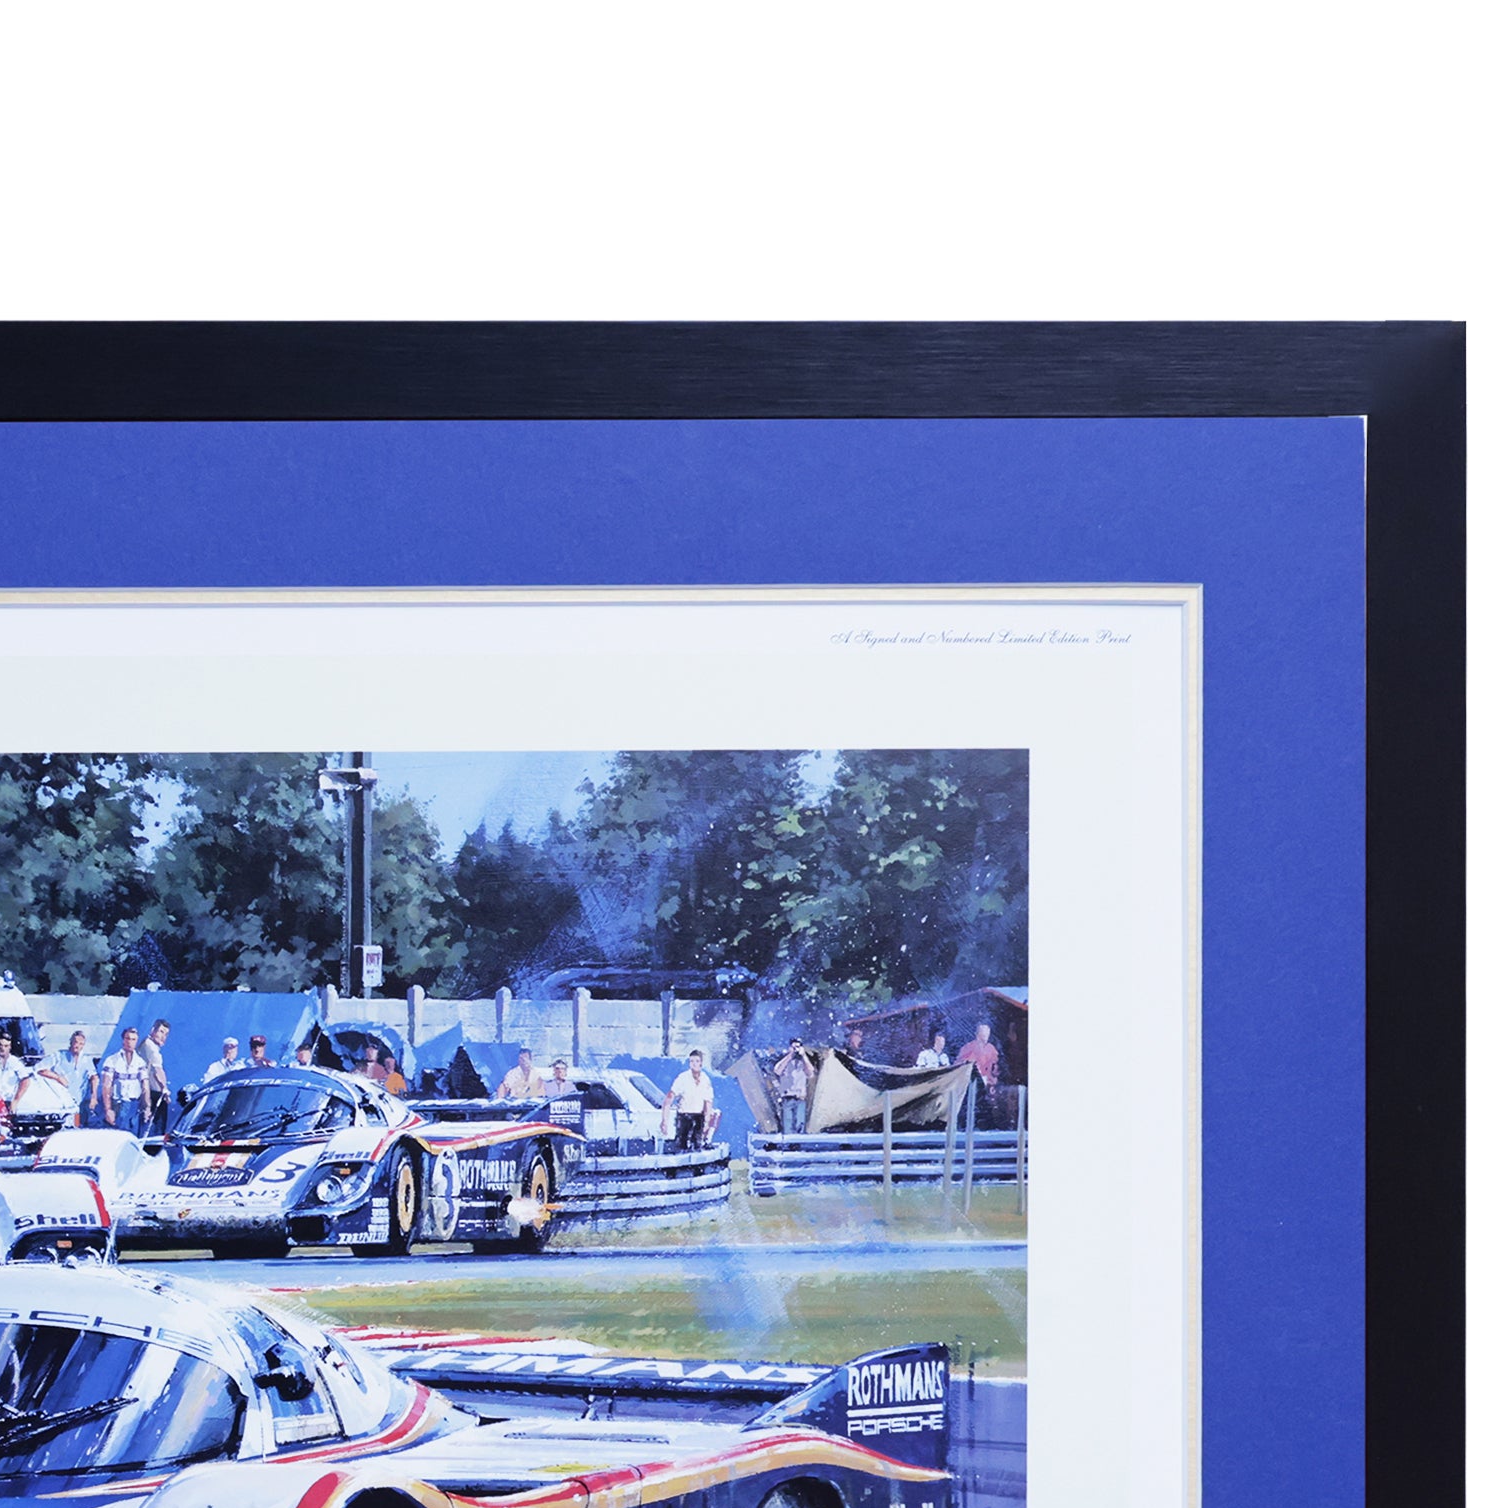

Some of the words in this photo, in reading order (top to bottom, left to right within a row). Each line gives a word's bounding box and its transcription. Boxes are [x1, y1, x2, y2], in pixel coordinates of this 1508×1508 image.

[854, 629, 898, 649] Signed
[900, 632, 926, 644] and
[926, 629, 995, 645] Numbered
[997, 629, 1047, 645] Limited
[1048, 629, 1090, 645] Edition
[1095, 629, 1132, 645] Print
[260, 1161, 307, 1183] 3
[14, 1213, 97, 1229] Shell
[847, 1361, 945, 1405] ROTHMANS
[847, 1414, 944, 1435] PORSCHE
